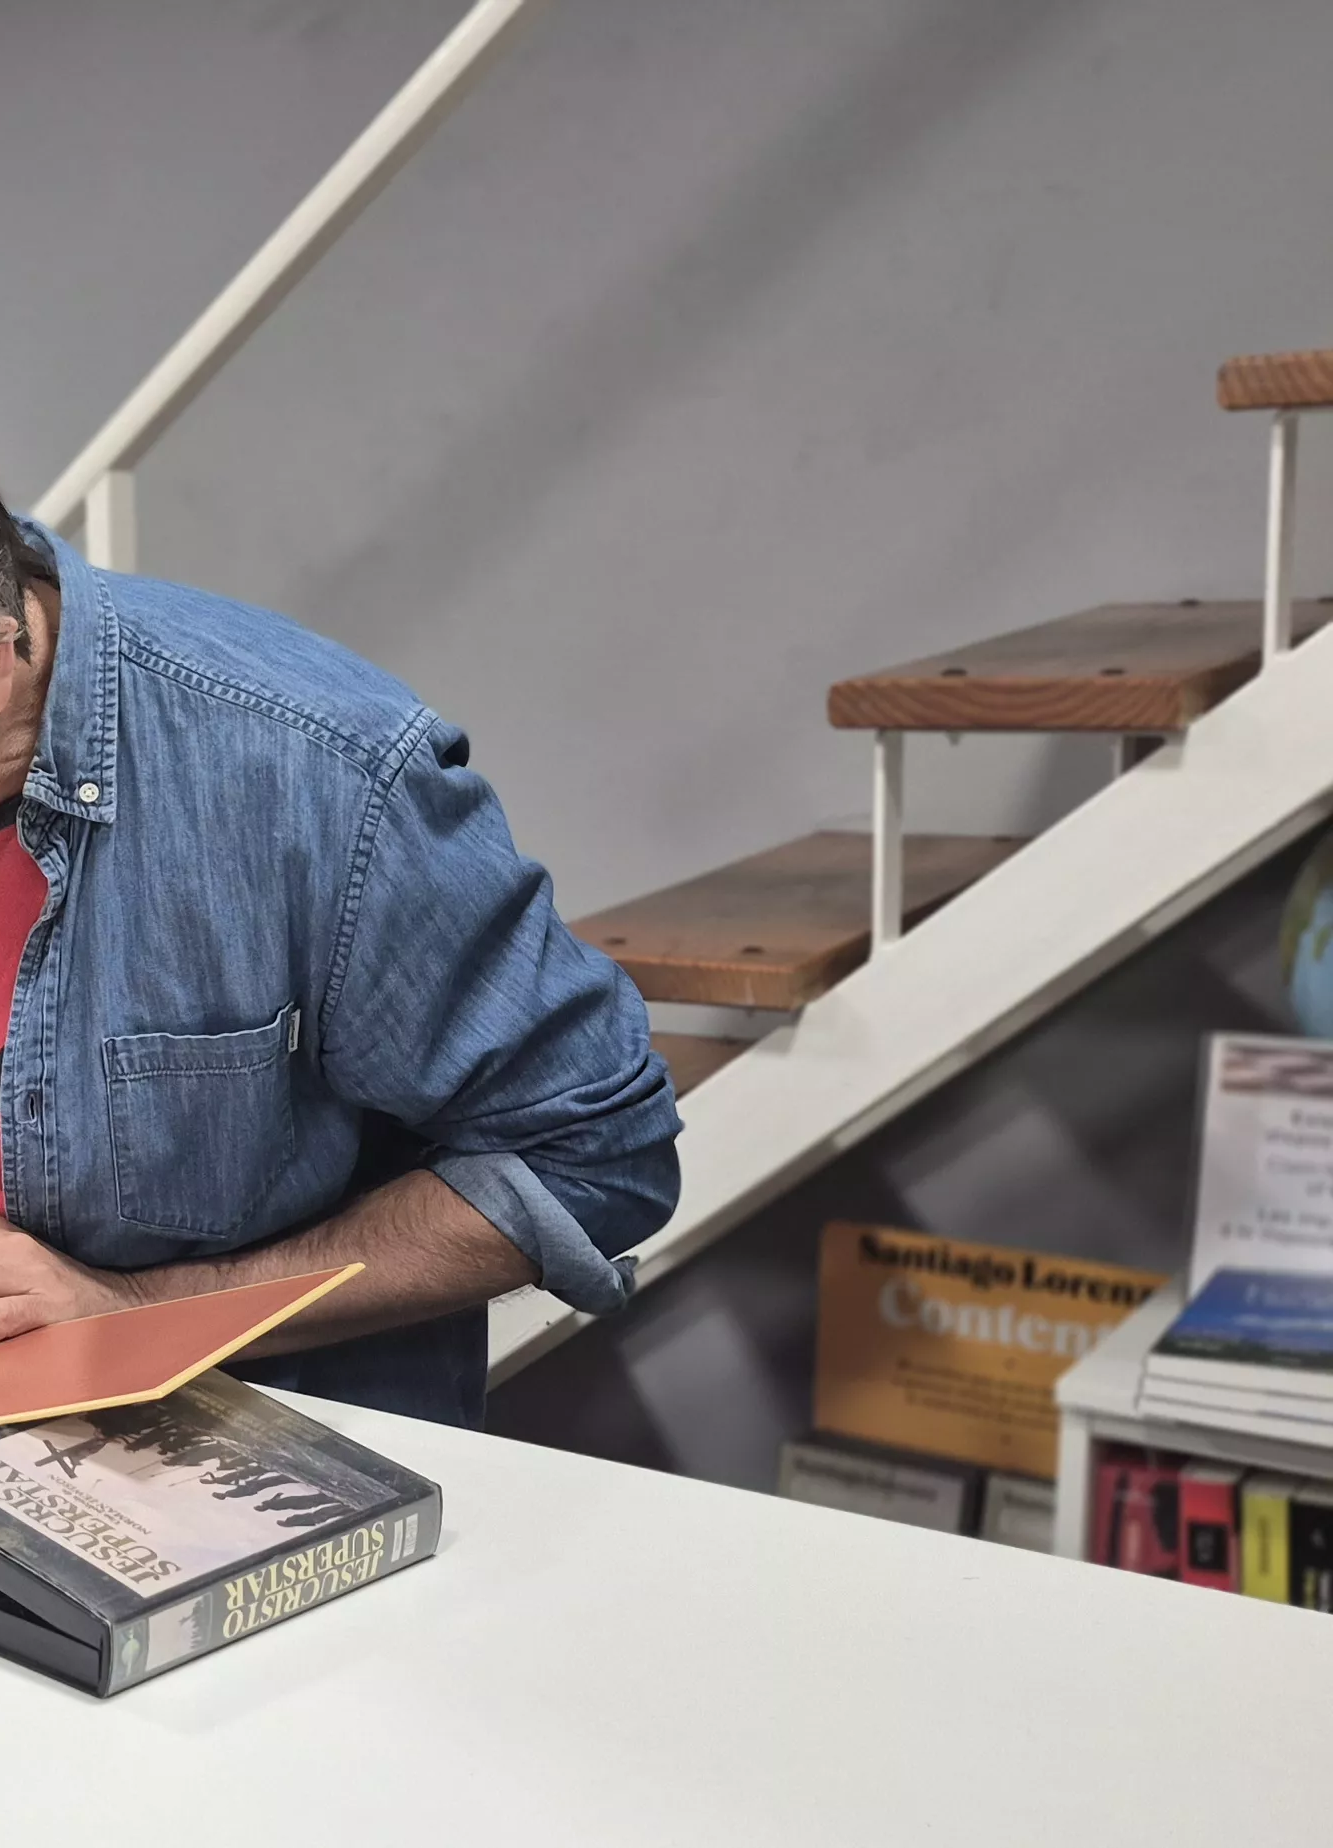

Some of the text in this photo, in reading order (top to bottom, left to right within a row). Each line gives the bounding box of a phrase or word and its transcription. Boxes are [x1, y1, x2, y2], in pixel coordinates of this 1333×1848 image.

[859, 1232, 1017, 1290] Santiago
[99, 1503, 152, 1535] NORMAN
[222, 1549, 384, 1639] JESUCRISTO
[224, 1519, 385, 1611] SUPERSTAR
